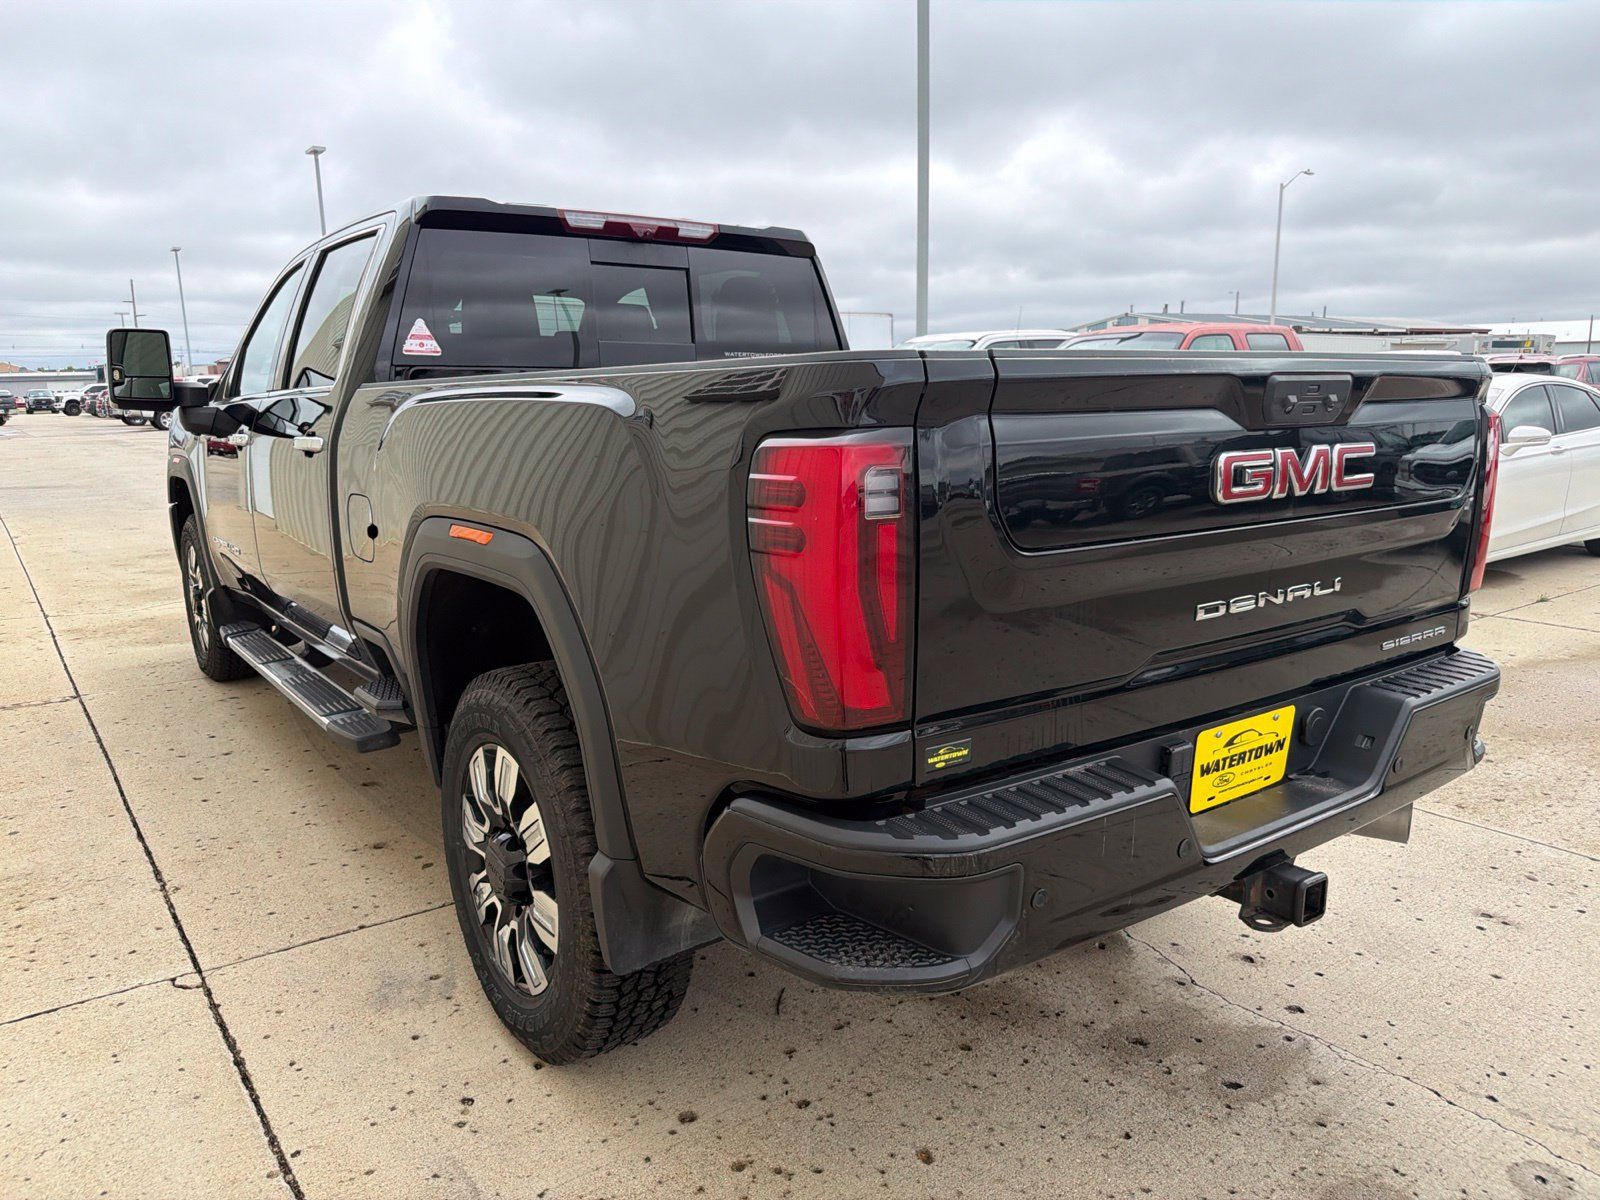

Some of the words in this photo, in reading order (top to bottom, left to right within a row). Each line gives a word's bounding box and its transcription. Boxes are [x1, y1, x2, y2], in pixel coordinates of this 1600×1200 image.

[1214, 443, 1376, 504] GMC
[1195, 577, 1342, 621] DENALI
[1380, 625, 1446, 651] SIERRA
[927, 749, 969, 763] WATERTOWN
[1200, 737, 1286, 778] WATERTOWN
